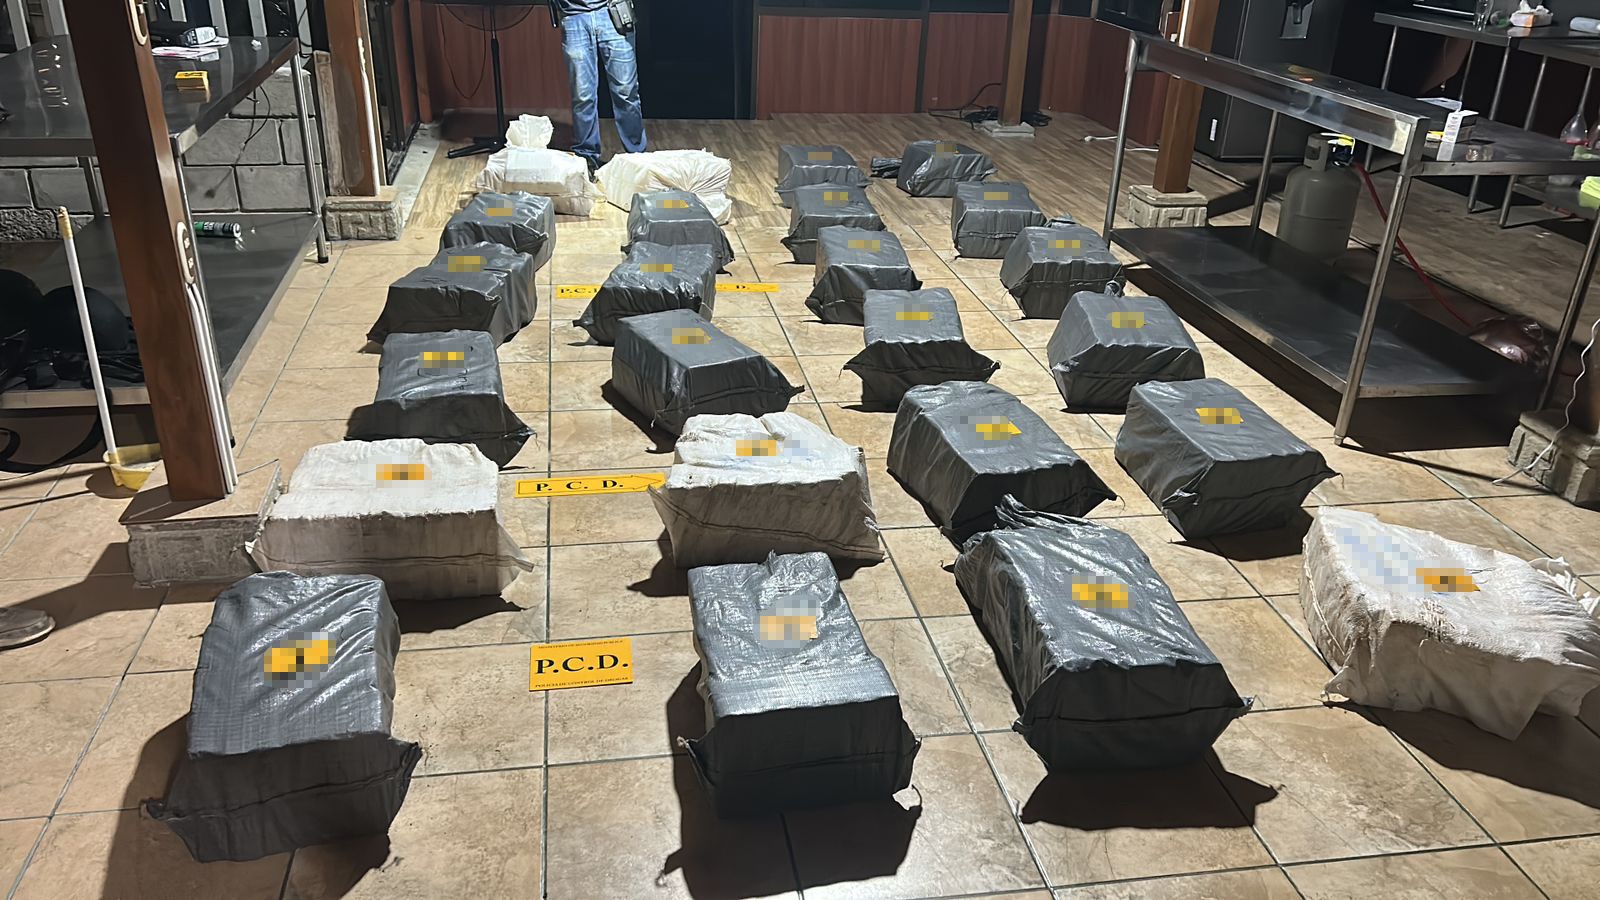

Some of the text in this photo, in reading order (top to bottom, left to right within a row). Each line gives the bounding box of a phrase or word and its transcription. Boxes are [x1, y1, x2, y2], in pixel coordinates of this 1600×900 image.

[536, 479, 624, 492] P. C. D.
[535, 654, 629, 674] P.C.D.
